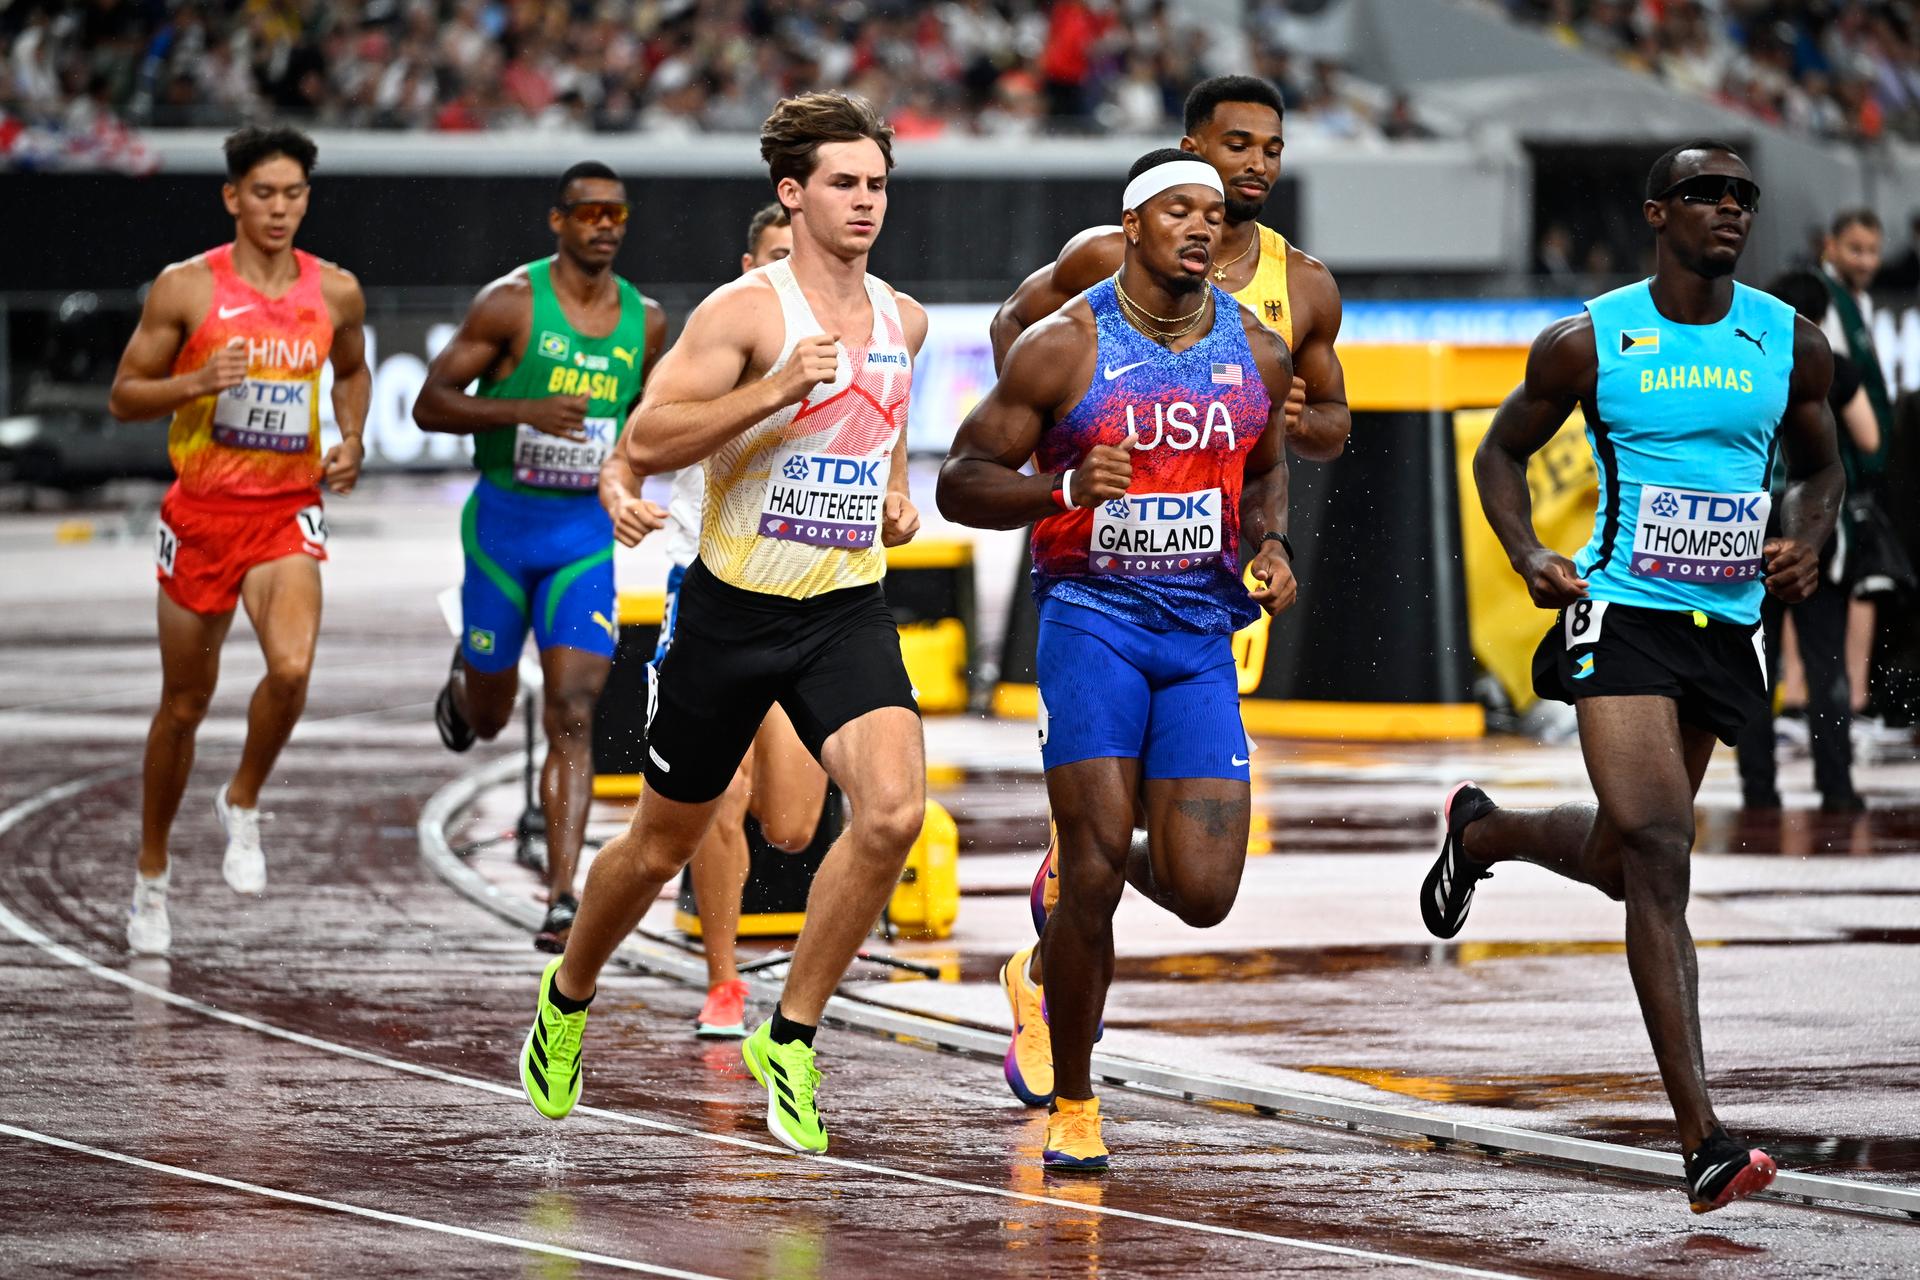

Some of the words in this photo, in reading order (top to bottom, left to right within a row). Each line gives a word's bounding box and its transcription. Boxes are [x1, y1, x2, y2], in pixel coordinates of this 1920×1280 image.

[867, 352, 898, 364] Allianz
[251, 381, 305, 404] TDK
[547, 365, 618, 403] BRASIL
[1640, 365, 1753, 393] BAHAMAS
[247, 407, 286, 431] FEI
[1126, 401, 1236, 451] USA
[808, 456, 880, 486] TDK
[769, 484, 879, 522] HAUTTEKEETE
[1130, 493, 1212, 522] TDK
[1680, 494, 1762, 523] TDK
[158, 529, 174, 566] 14
[1098, 524, 1214, 553] GARLAND
[1642, 522, 1761, 558] THOMPSON
[1571, 598, 1593, 637] 8
